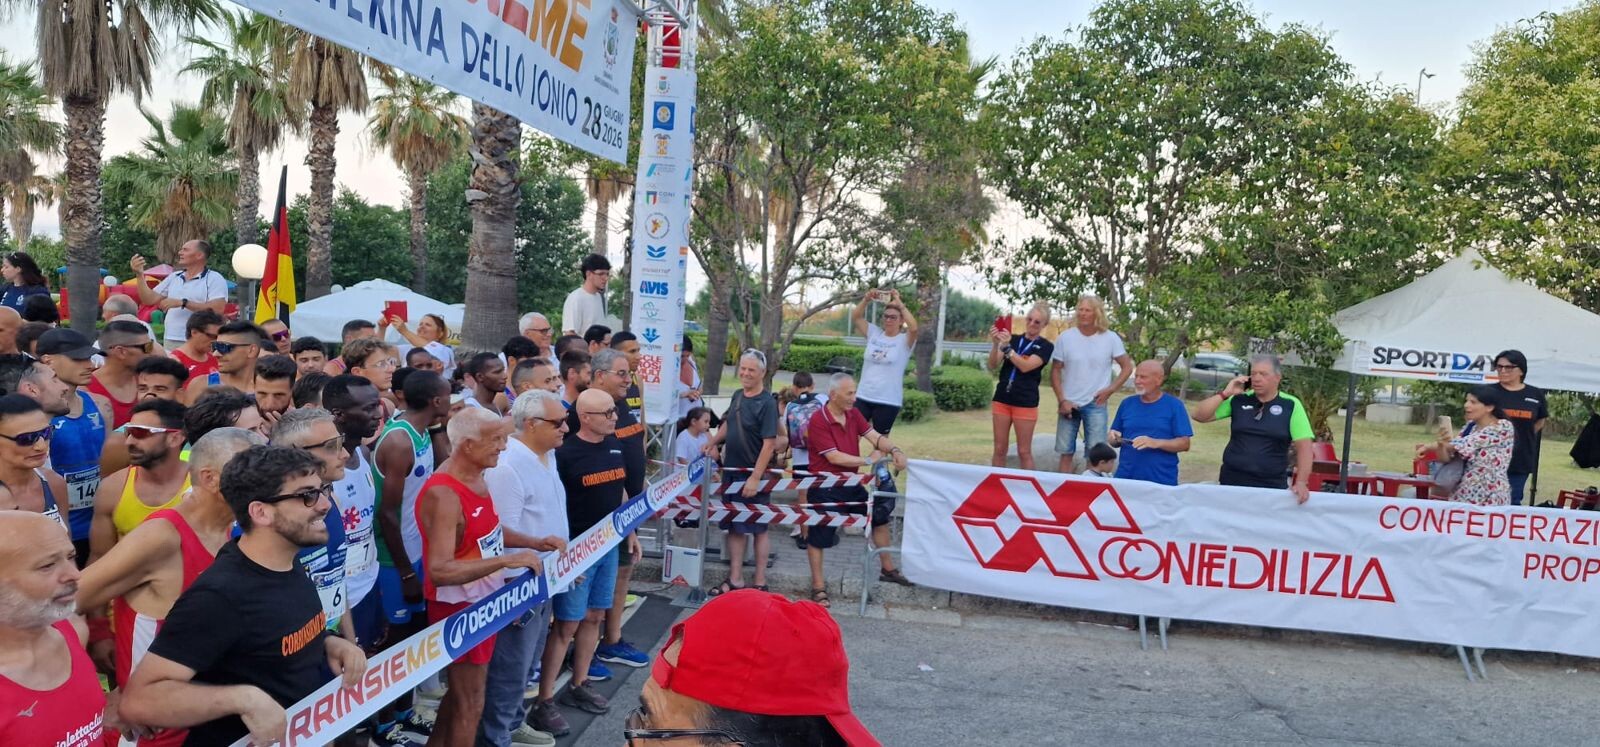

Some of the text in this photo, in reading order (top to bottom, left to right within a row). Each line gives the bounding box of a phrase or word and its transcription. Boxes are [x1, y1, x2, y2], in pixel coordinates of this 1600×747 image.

[461, 21, 525, 98] DELLO
[530, 64, 578, 126] IONIO
[581, 96, 601, 140] 28
[602, 123, 623, 149] 2026
[640, 280, 669, 296] AVIS
[1372, 346, 1498, 372] SPORTDAY
[1379, 504, 1600, 546] CONFEDERAZI
[363, 543, 370, 561] 7
[1098, 535, 1396, 603] CONFEDILIZIA
[1523, 553, 1600, 582] PROP
[333, 587, 342, 607] 6
[246, 629, 441, 747] RRINSIEME
[468, 577, 540, 634] DECATHLON
[556, 520, 616, 578] CORRINSIEME
[620, 497, 649, 528] DECATHLON
